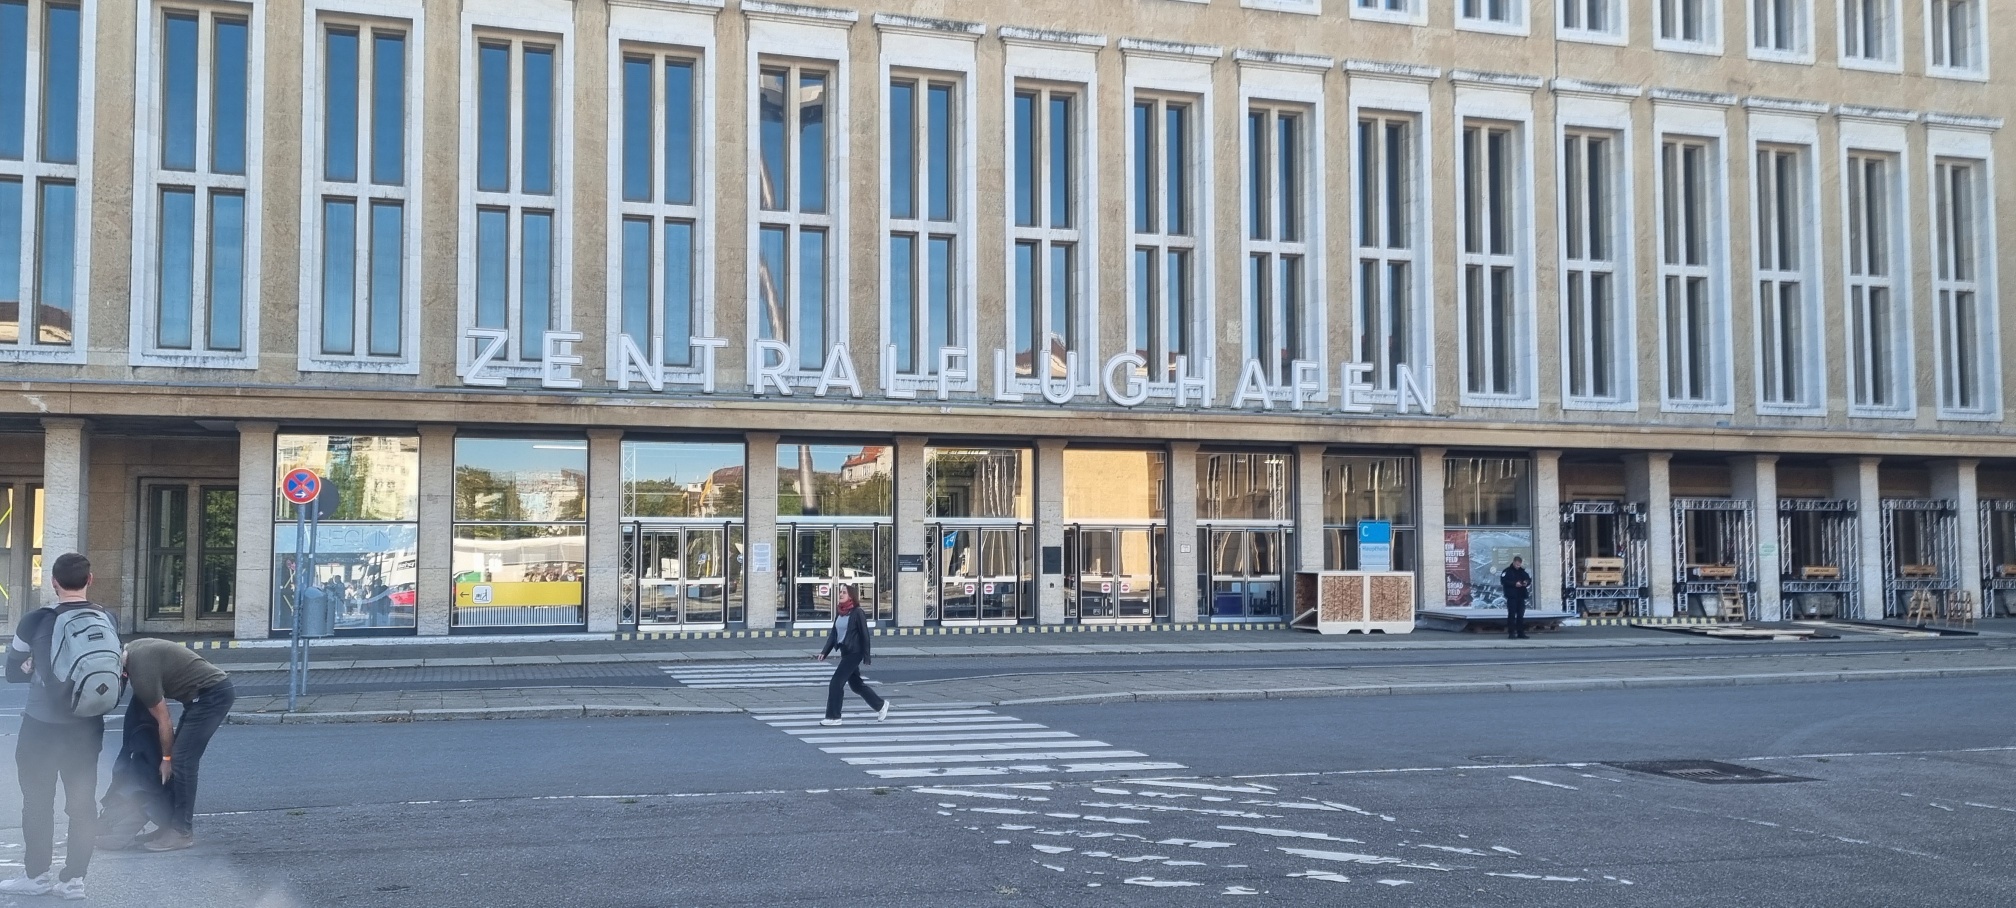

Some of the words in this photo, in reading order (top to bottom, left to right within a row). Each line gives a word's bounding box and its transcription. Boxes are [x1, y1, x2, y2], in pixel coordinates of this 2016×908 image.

[463, 327, 1434, 414] ZENTRALFLUGHAFEN
[1362, 525, 1369, 537] C
[1447, 588, 1461, 596] FIELD
